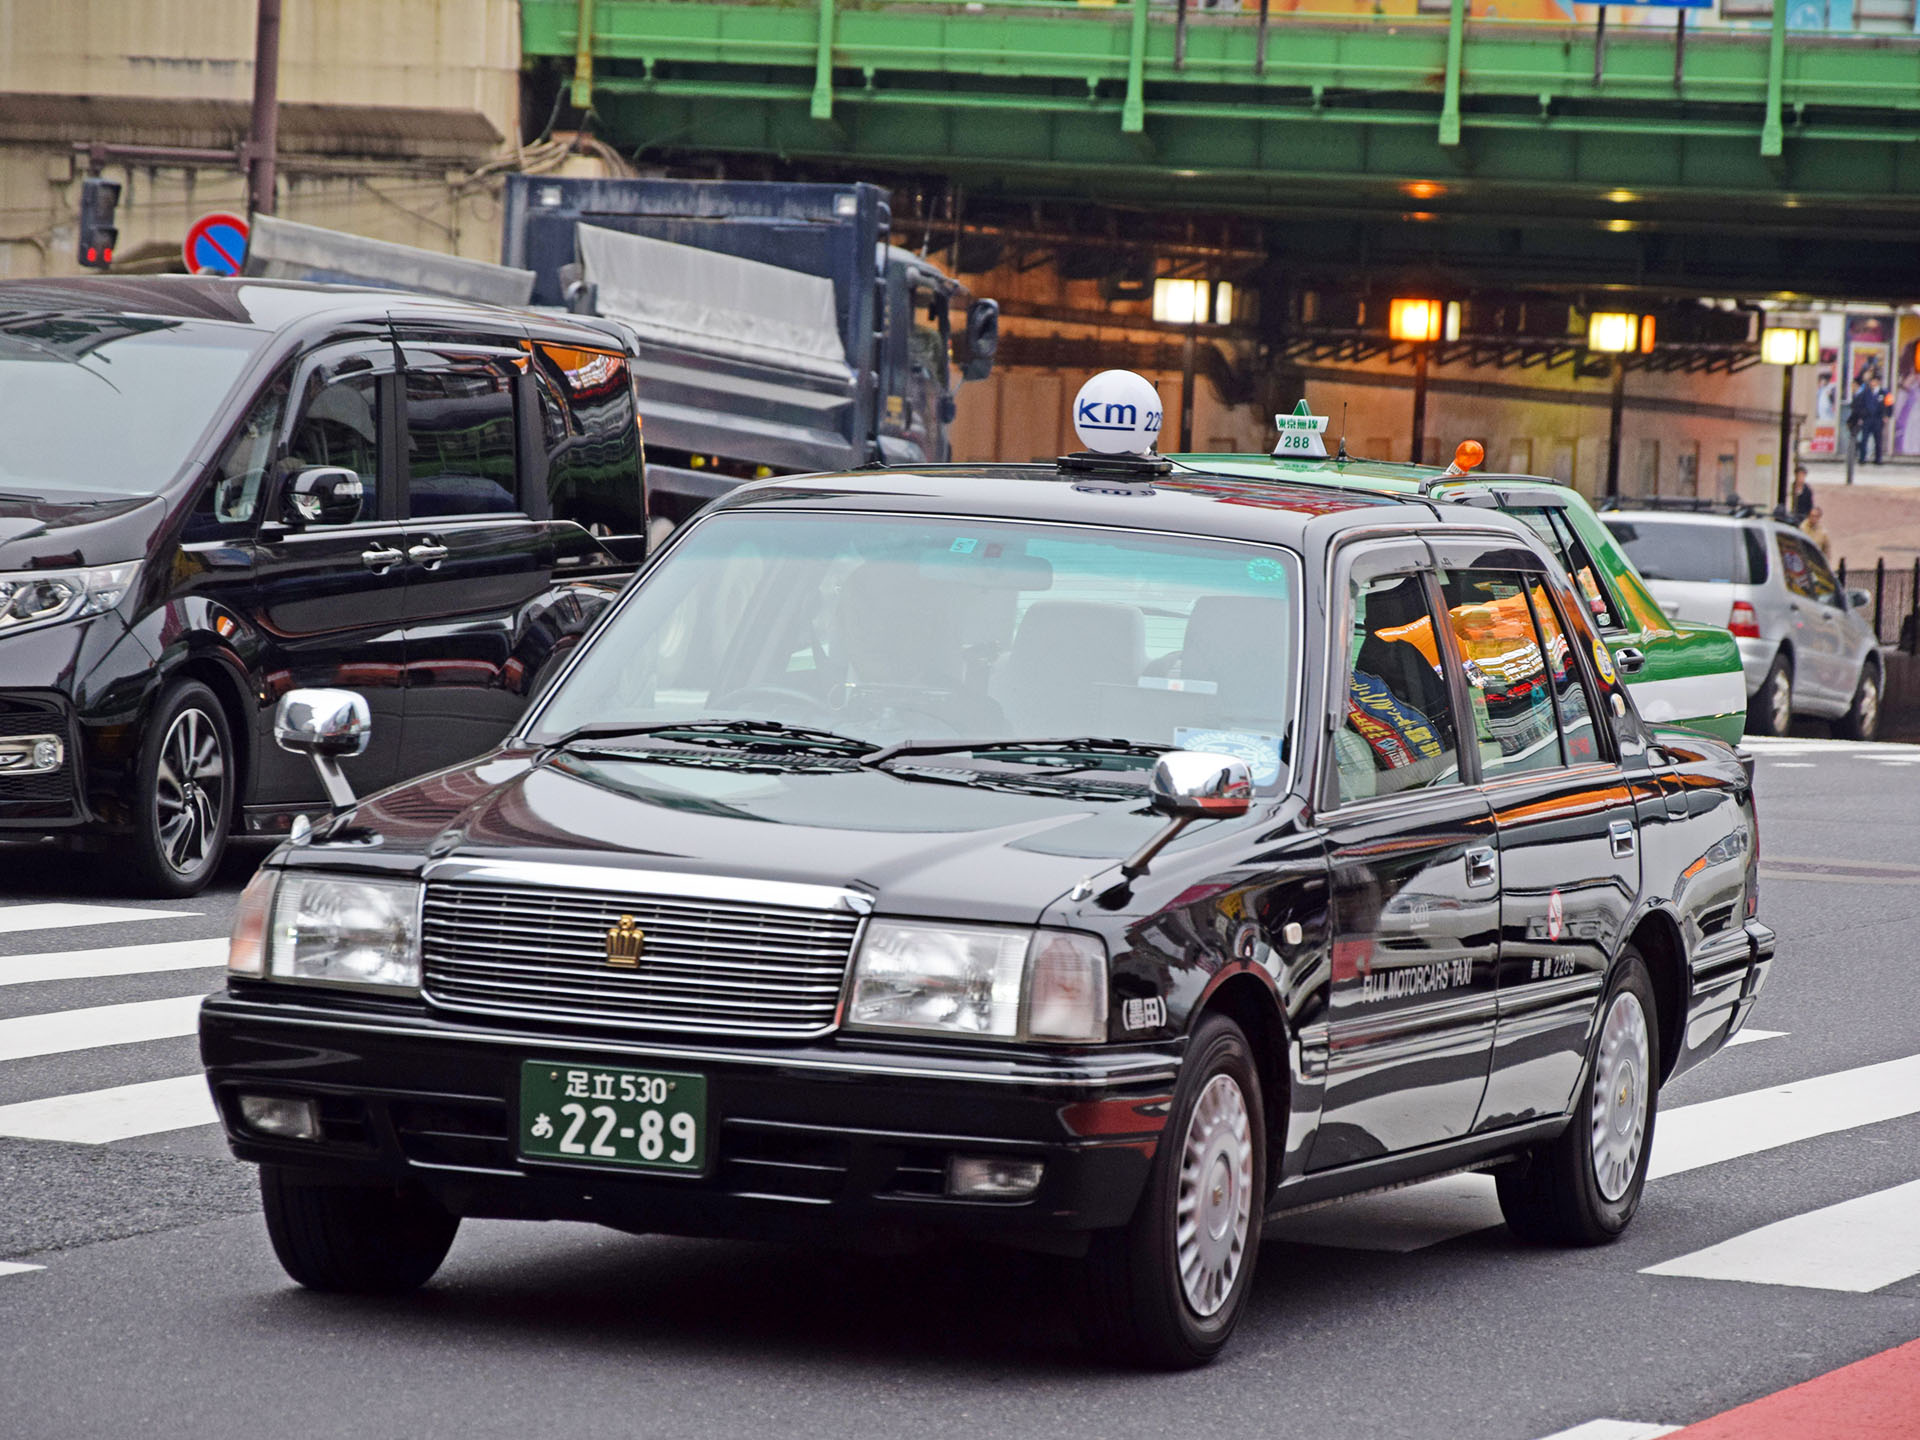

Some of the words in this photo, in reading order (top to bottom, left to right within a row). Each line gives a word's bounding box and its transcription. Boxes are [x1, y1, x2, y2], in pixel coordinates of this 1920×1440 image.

[1079, 398, 1136, 425] km
[1284, 436, 1310, 449] 288
[1387, 961, 1449, 999] MOTORCARS
[1451, 956, 1473, 987] TAXI
[1553, 951, 1576, 978] 2289
[565, 1070, 616, 1100] 足立
[620, 1075, 667, 1104] 530
[530, 1112, 554, 1139] あ
[559, 1102, 696, 1164] 22-89
